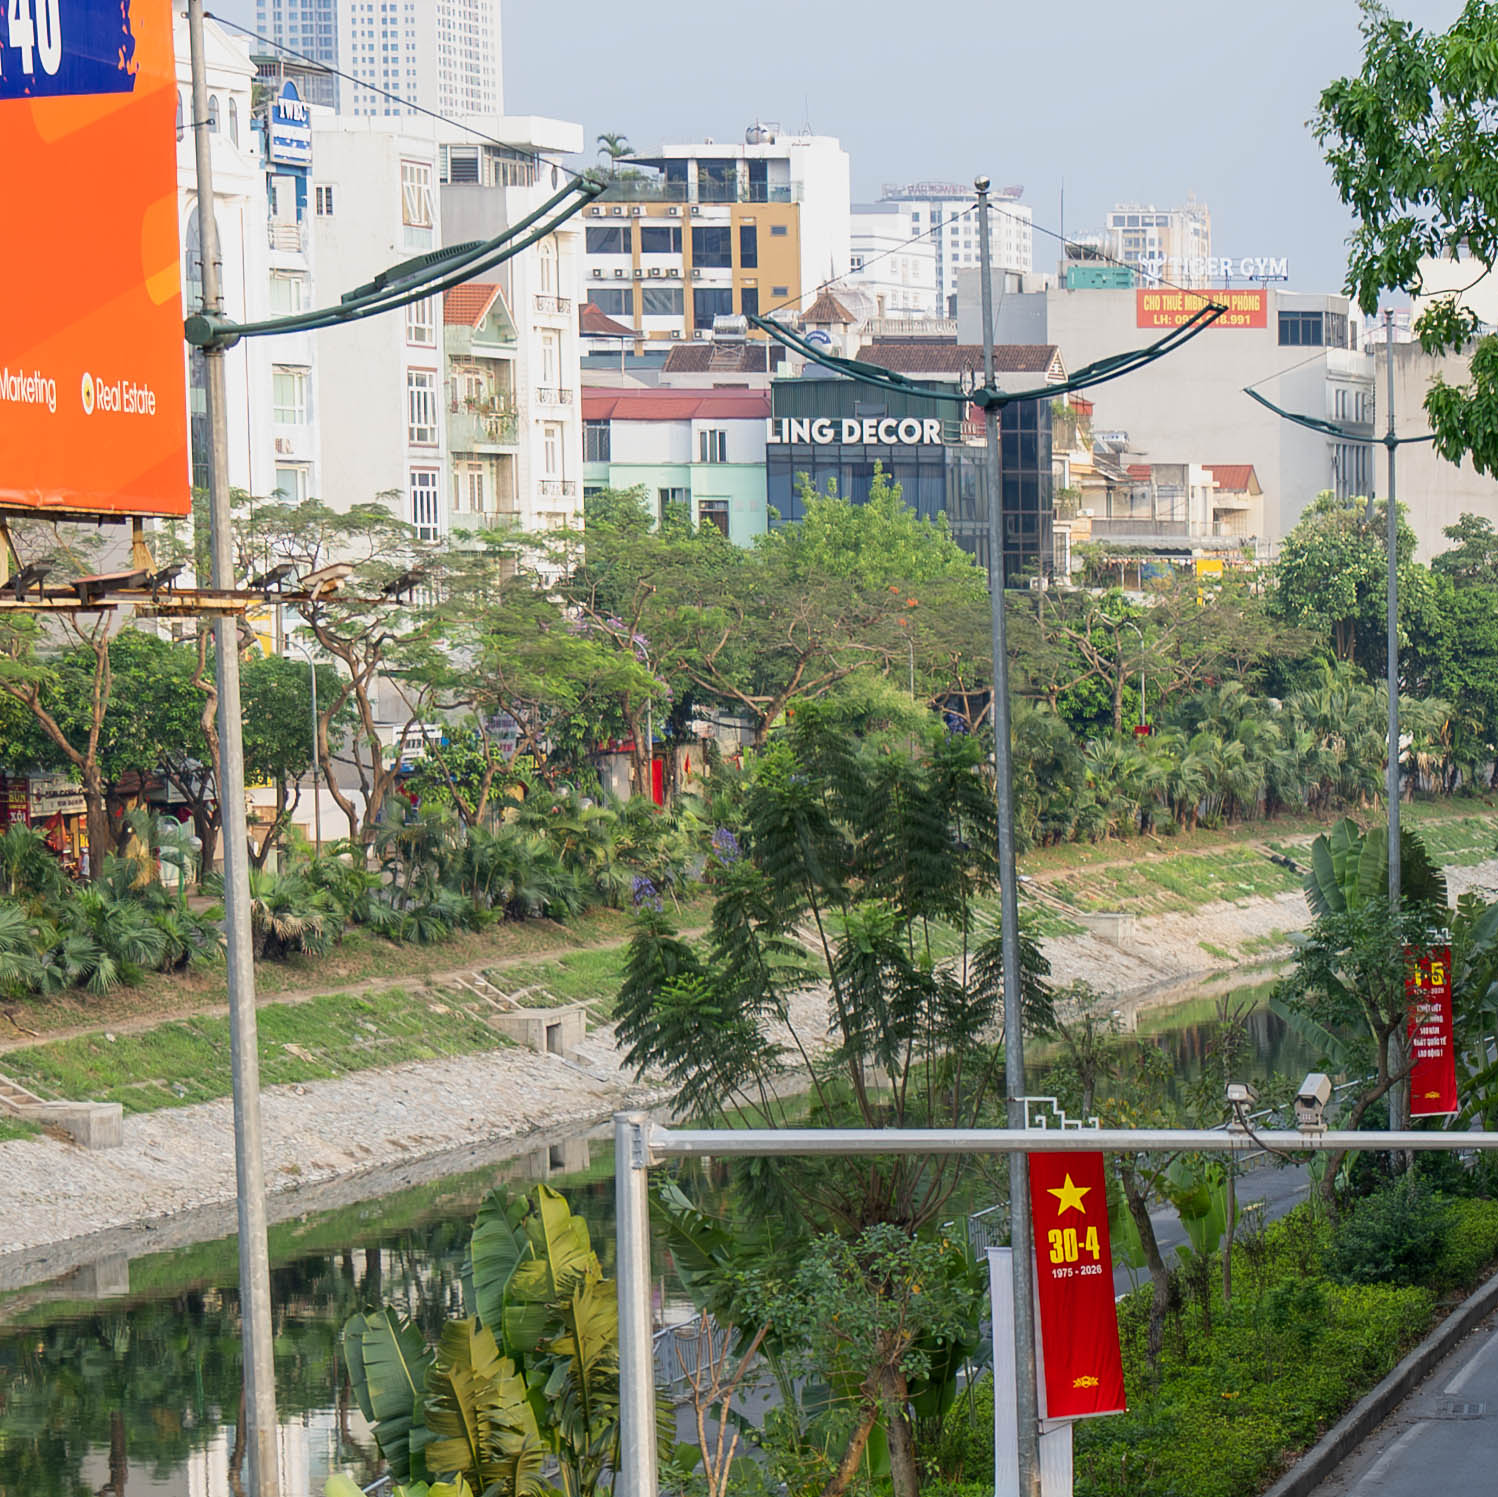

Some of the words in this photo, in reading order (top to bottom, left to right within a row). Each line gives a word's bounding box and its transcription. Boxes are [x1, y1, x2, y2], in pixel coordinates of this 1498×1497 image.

[1240, 257, 1288, 276] GYM
[1143, 295, 1161, 311] CHO
[1162, 291, 1182, 311] THUÊ
[0, 367, 57, 414] Marketing
[96, 377, 121, 412] Real
[123, 380, 156, 416] Estate
[766, 417, 835, 445] LING
[842, 417, 942, 445] DECOR
[1048, 1226, 1100, 1264] 30-4
[1052, 1267, 1073, 1279] 1975
